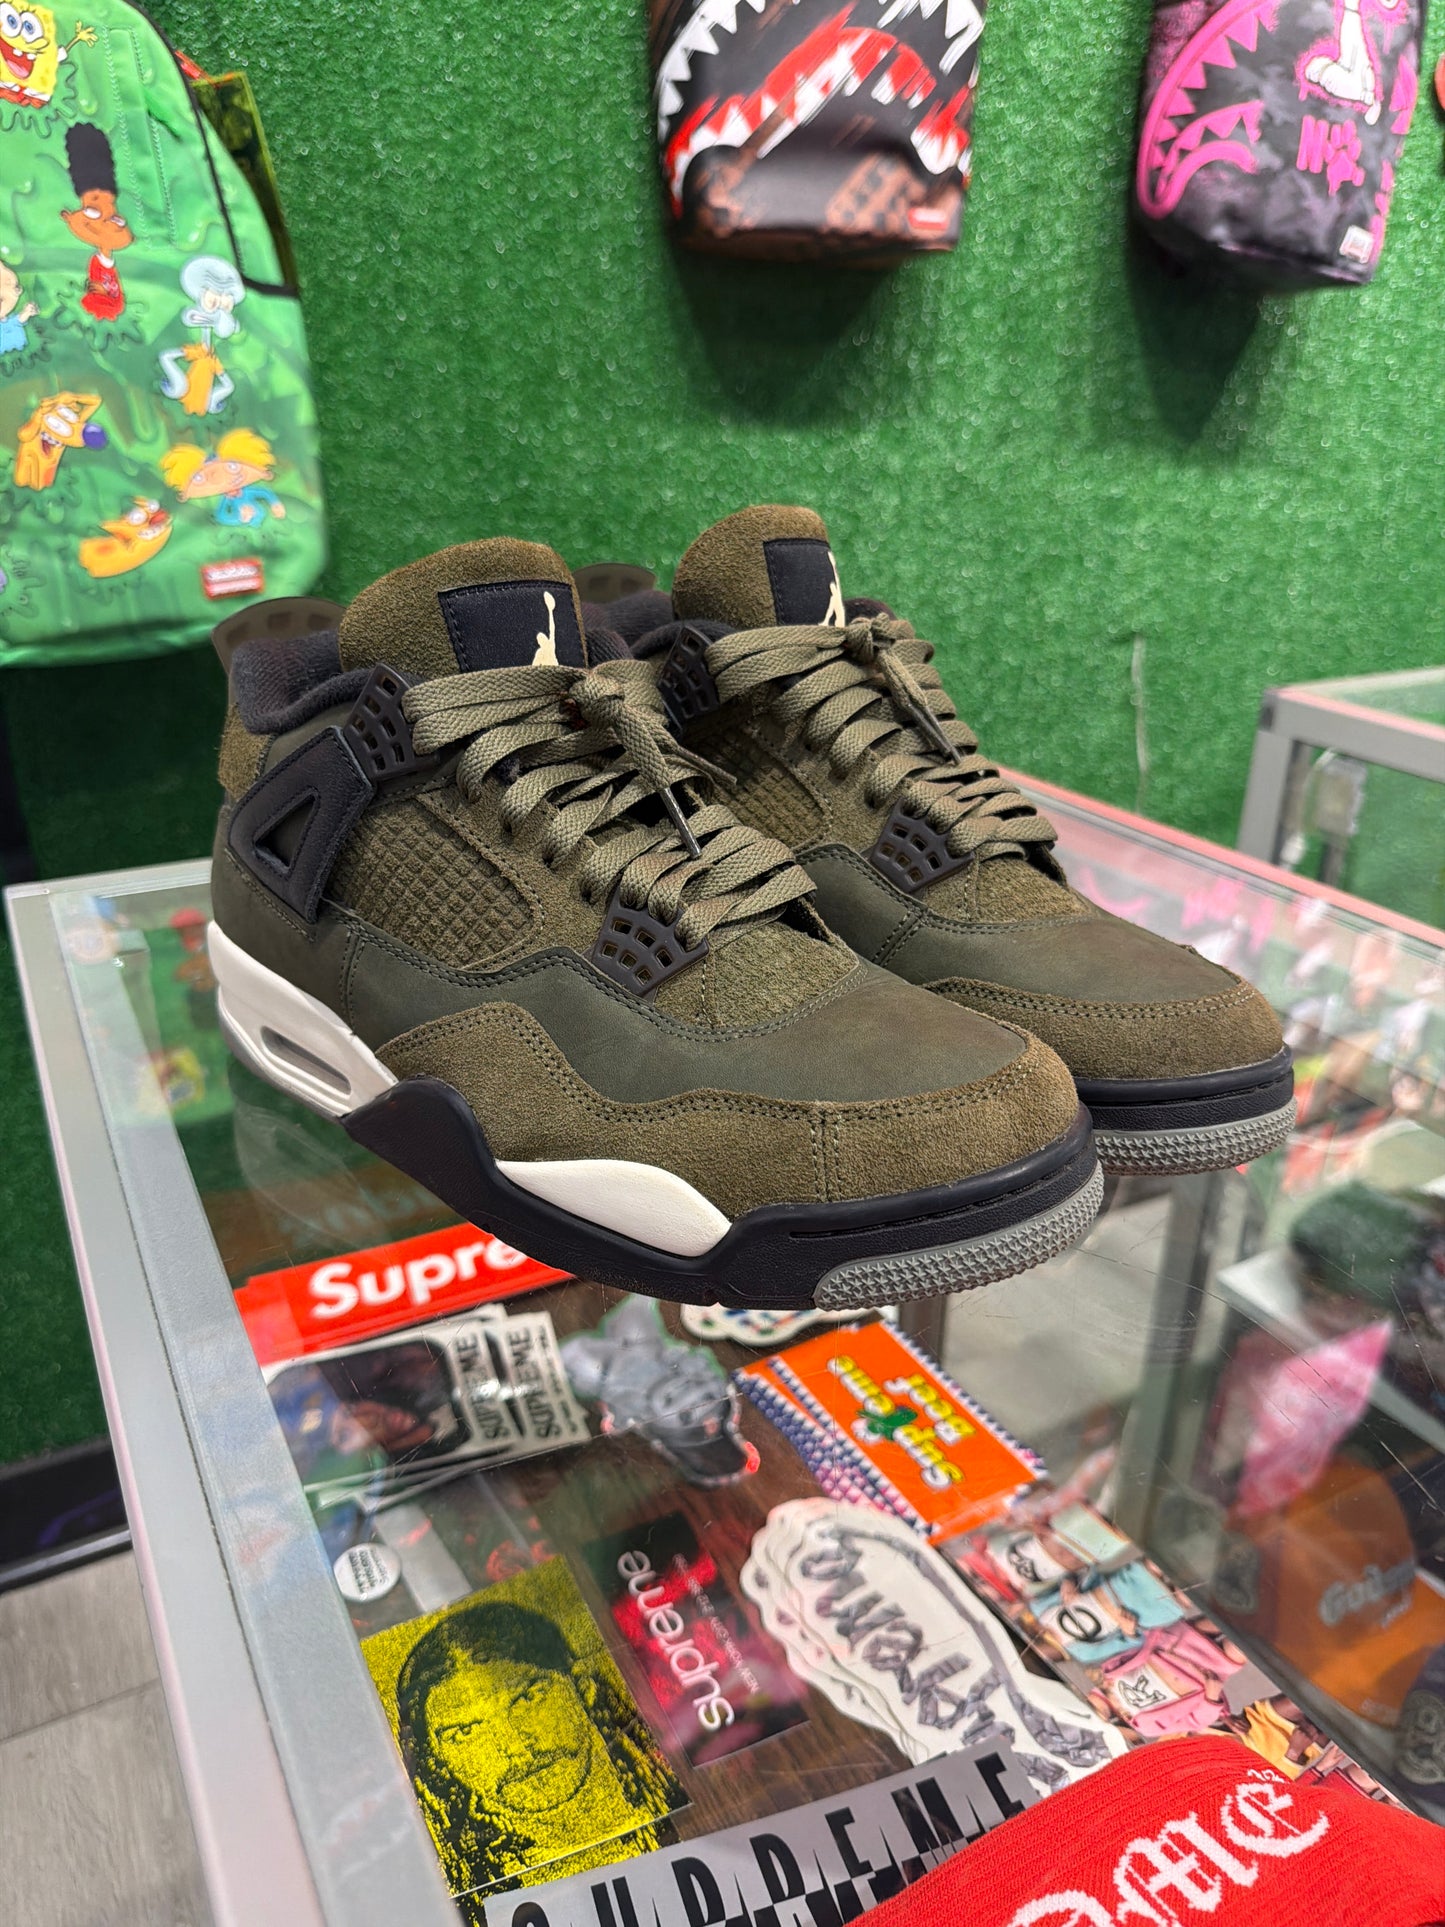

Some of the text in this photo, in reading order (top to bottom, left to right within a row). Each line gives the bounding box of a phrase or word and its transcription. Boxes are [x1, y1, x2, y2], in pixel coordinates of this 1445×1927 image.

[309, 1237, 528, 1319] Supre
[885, 1373, 976, 1445] Beef
[617, 1551, 735, 1731] supreme
[801, 1531, 1068, 1787] upreme
